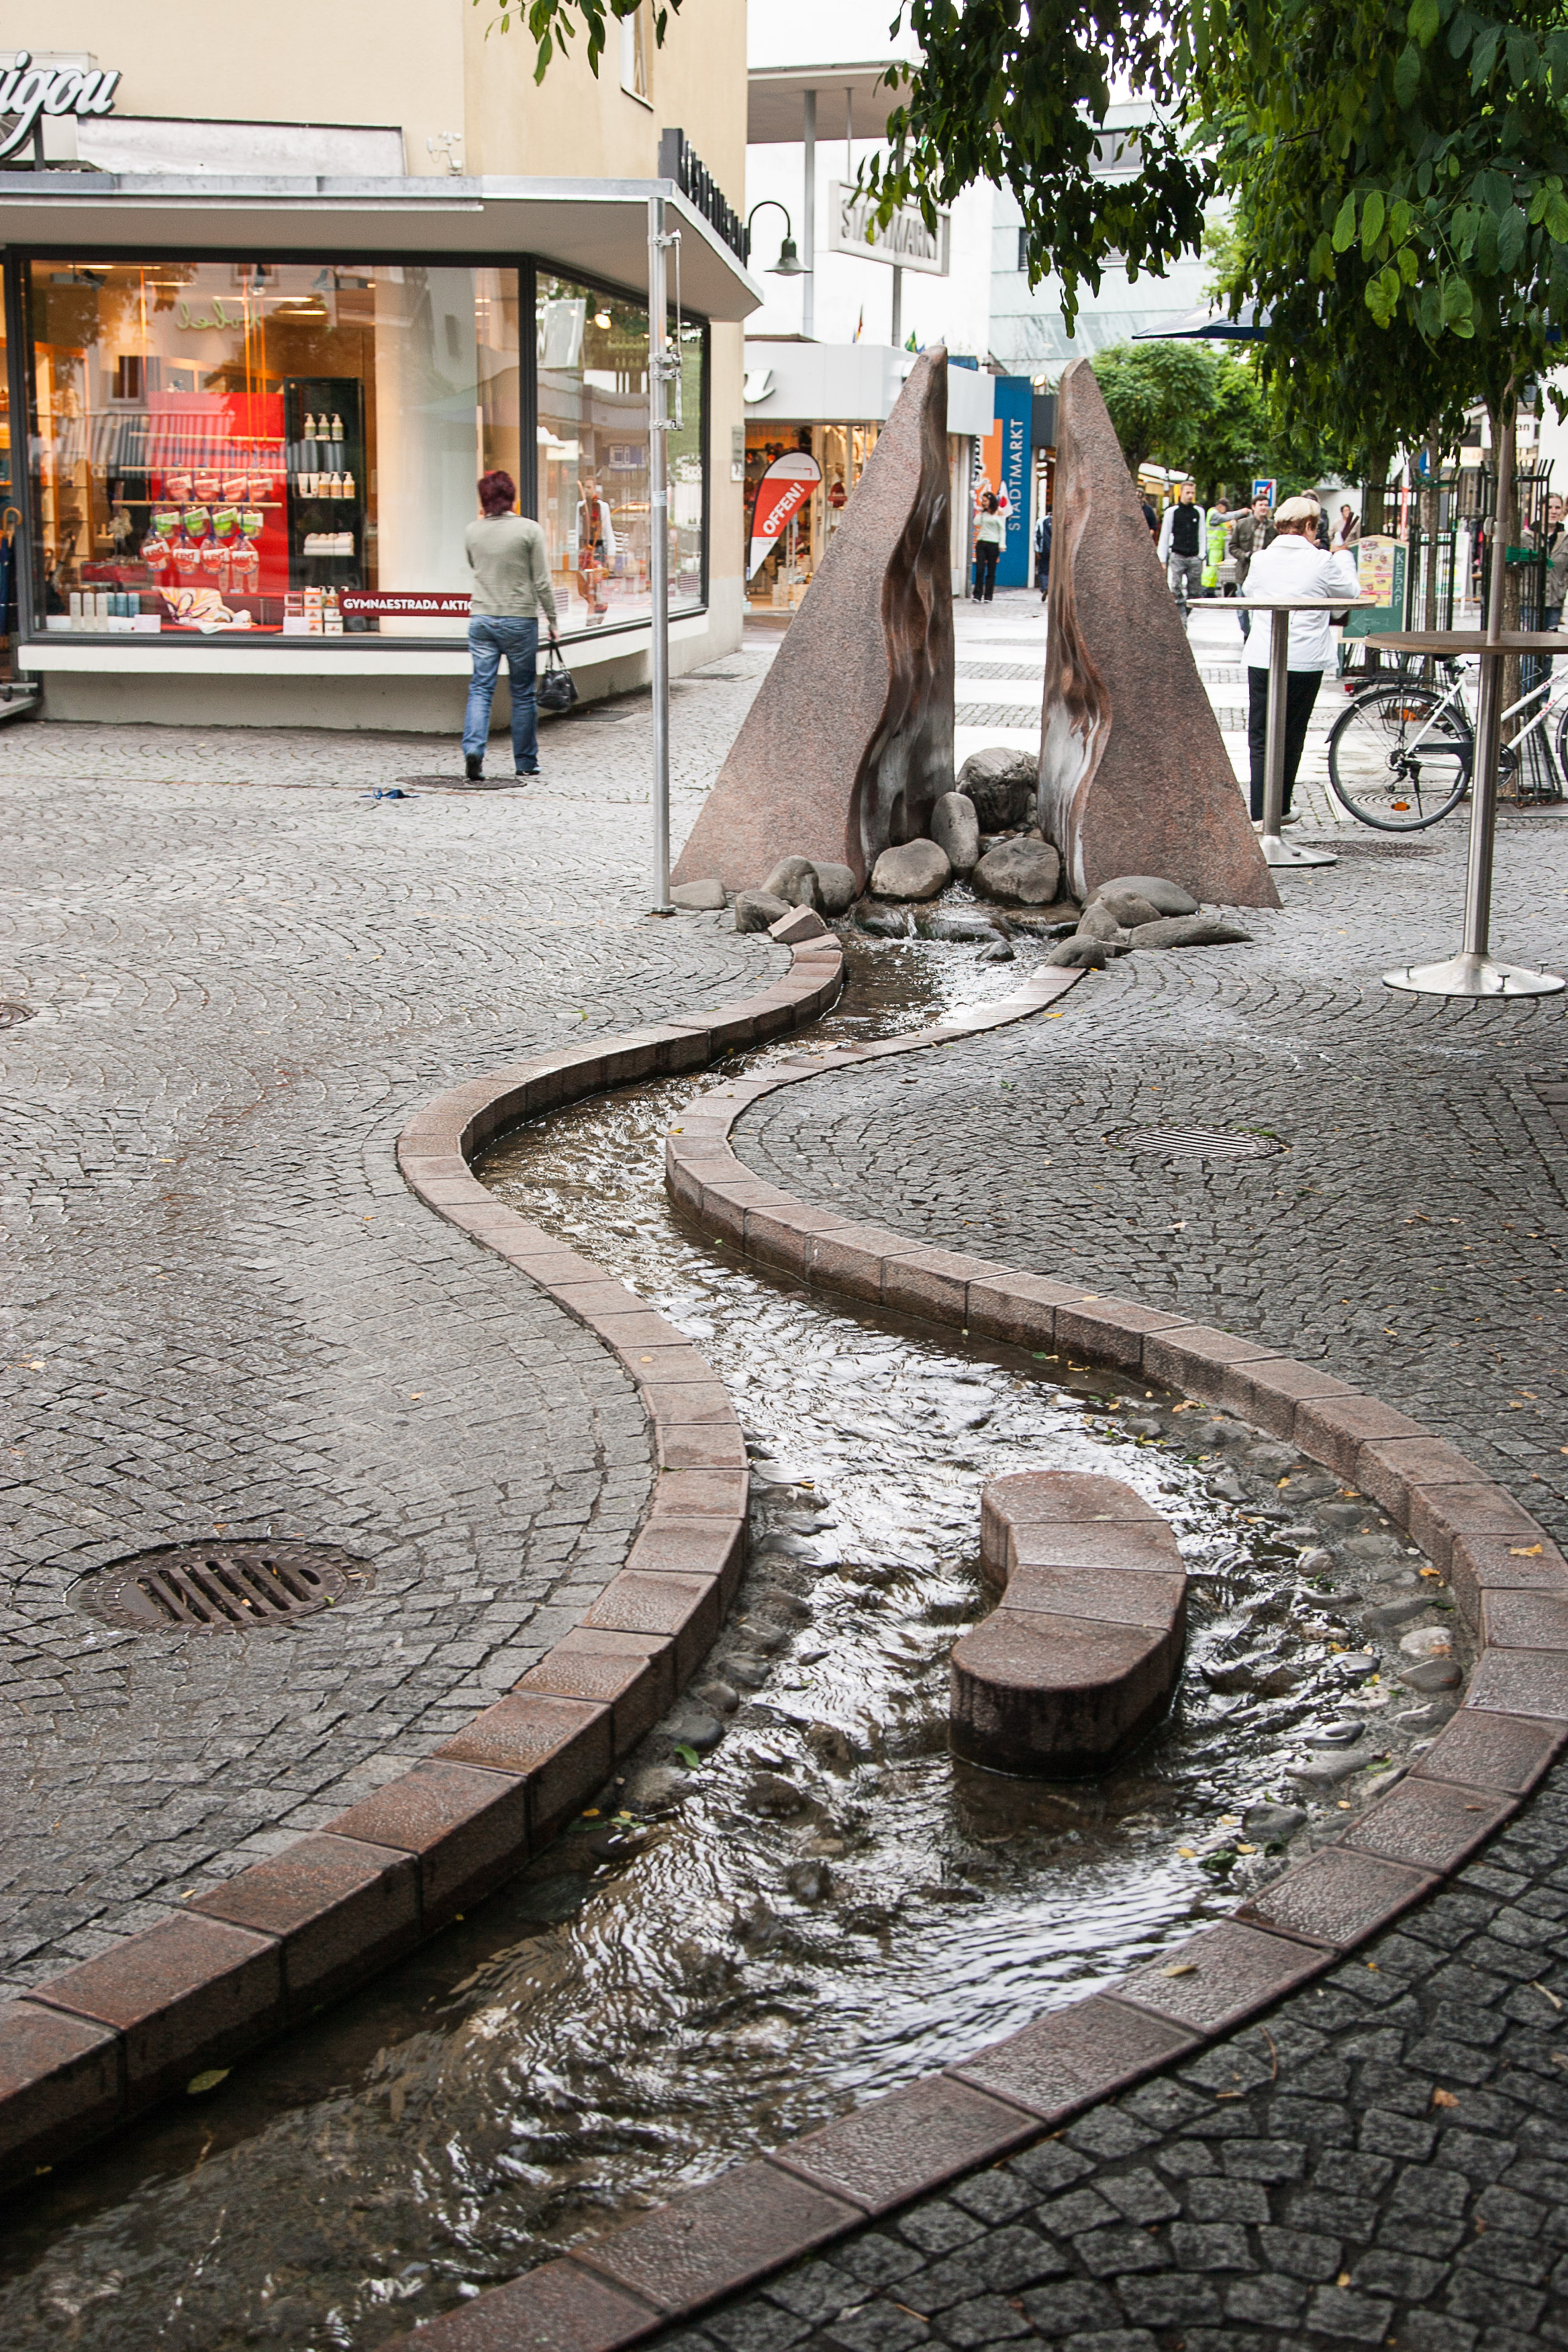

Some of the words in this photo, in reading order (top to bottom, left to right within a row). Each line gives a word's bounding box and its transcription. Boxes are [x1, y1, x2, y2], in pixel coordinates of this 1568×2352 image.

[0, 50, 122, 160] igou
[763, 482, 805, 534] OFFEN!
[1008, 418, 1024, 532] STADTMARKT
[343, 598, 439, 610] GYMNAESTRADA
